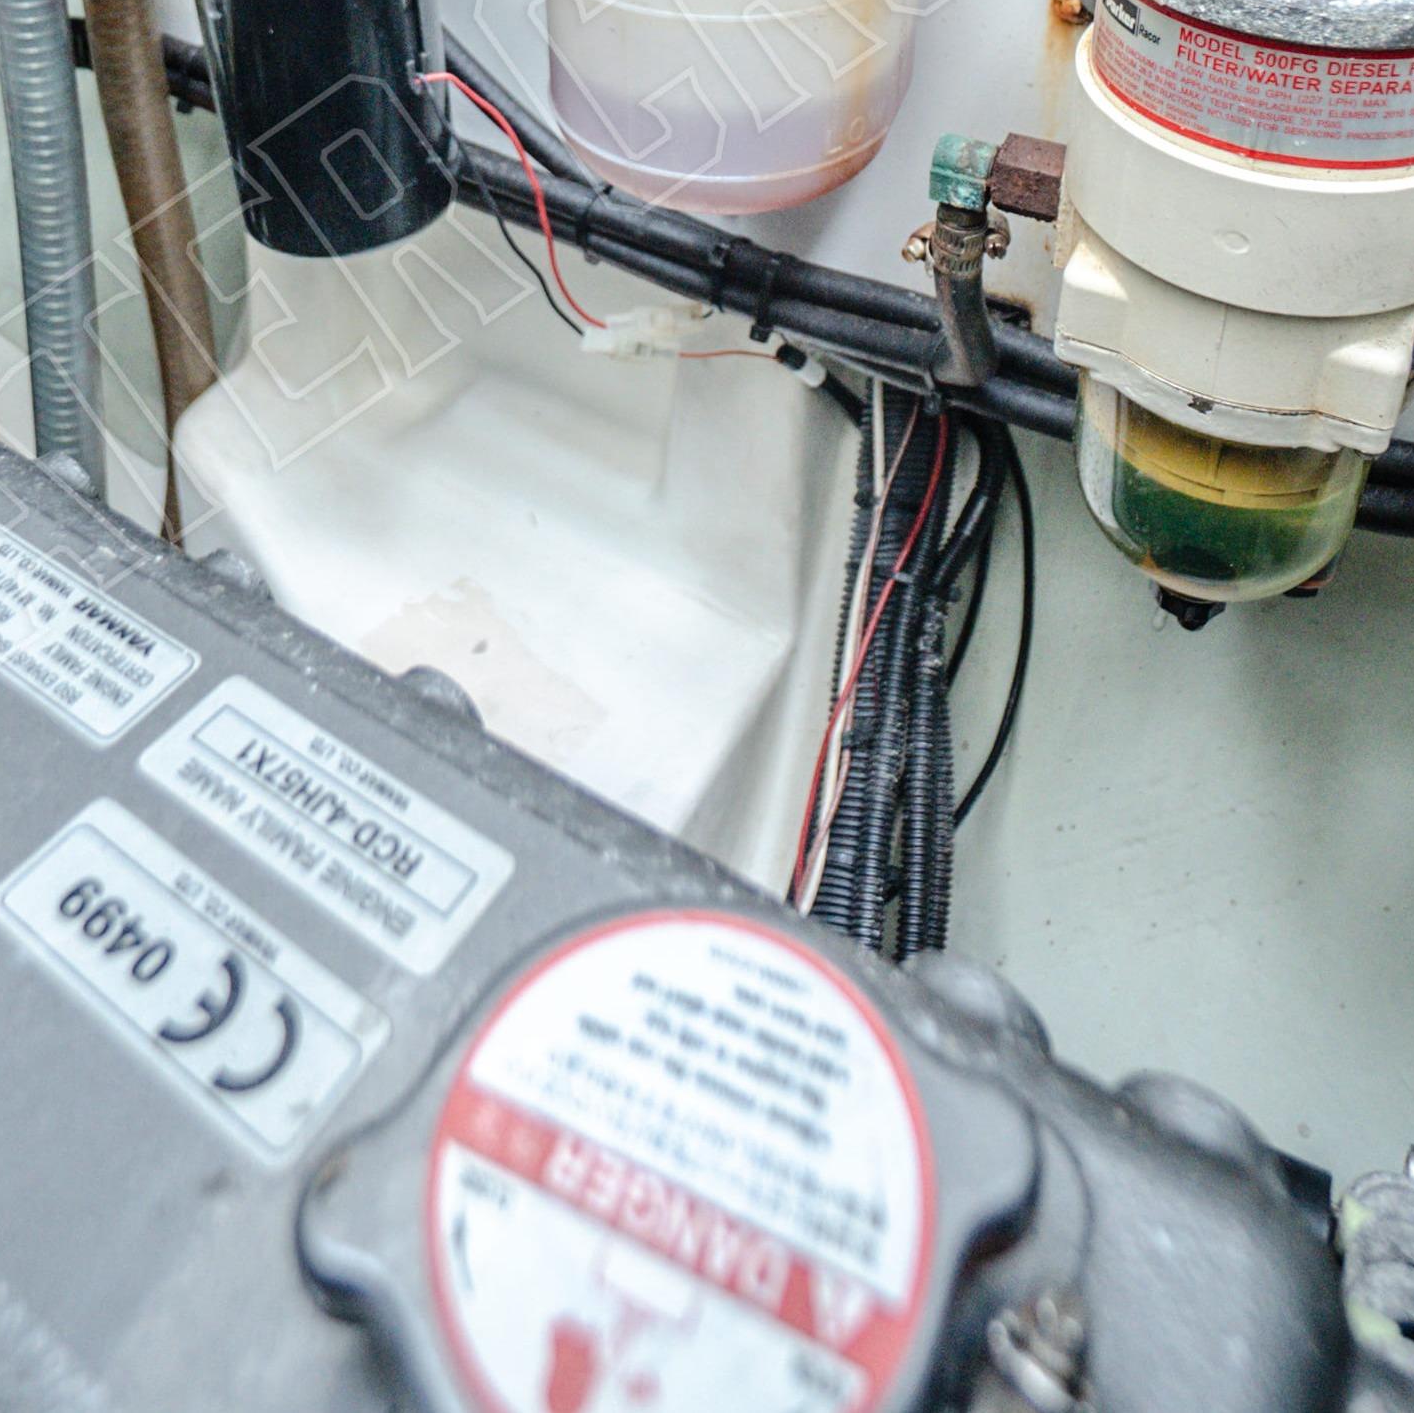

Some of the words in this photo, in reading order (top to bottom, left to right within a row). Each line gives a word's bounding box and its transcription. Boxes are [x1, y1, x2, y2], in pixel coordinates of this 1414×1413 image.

[1139, 24, 1161, 45] Racor
[1179, 27, 1244, 61] MODEL
[1254, 51, 1318, 73] 500FG
[1327, 61, 1400, 78] DIESEL
[1175, 61, 1202, 79] FLOW
[1177, 44, 1321, 91] FILTER/WATER
[1210, 98, 1233, 111] TEST
[1238, 103, 1293, 124] PRESSURE
[1256, 122, 1279, 133] FOR
[1284, 124, 1341, 139] SERVICING
[1329, 109, 1377, 119] ELEMENT
[73, 593, 157, 656] YANMAR
[6, 646, 60, 690] EXHAUST
[41, 637, 90, 678] FAMILY
[66, 620, 155, 690] CERTIFICATION
[83, 666, 135, 709] ENGINE
[173, 753, 248, 816] NAME
[231, 735, 426, 880] RCD-4JH57X1
[236, 799, 327, 875] FAMILY
[316, 857, 417, 941] ENGINE
[58, 878, 174, 984] 0499
[541, 1138, 791, 1302] DANGER
